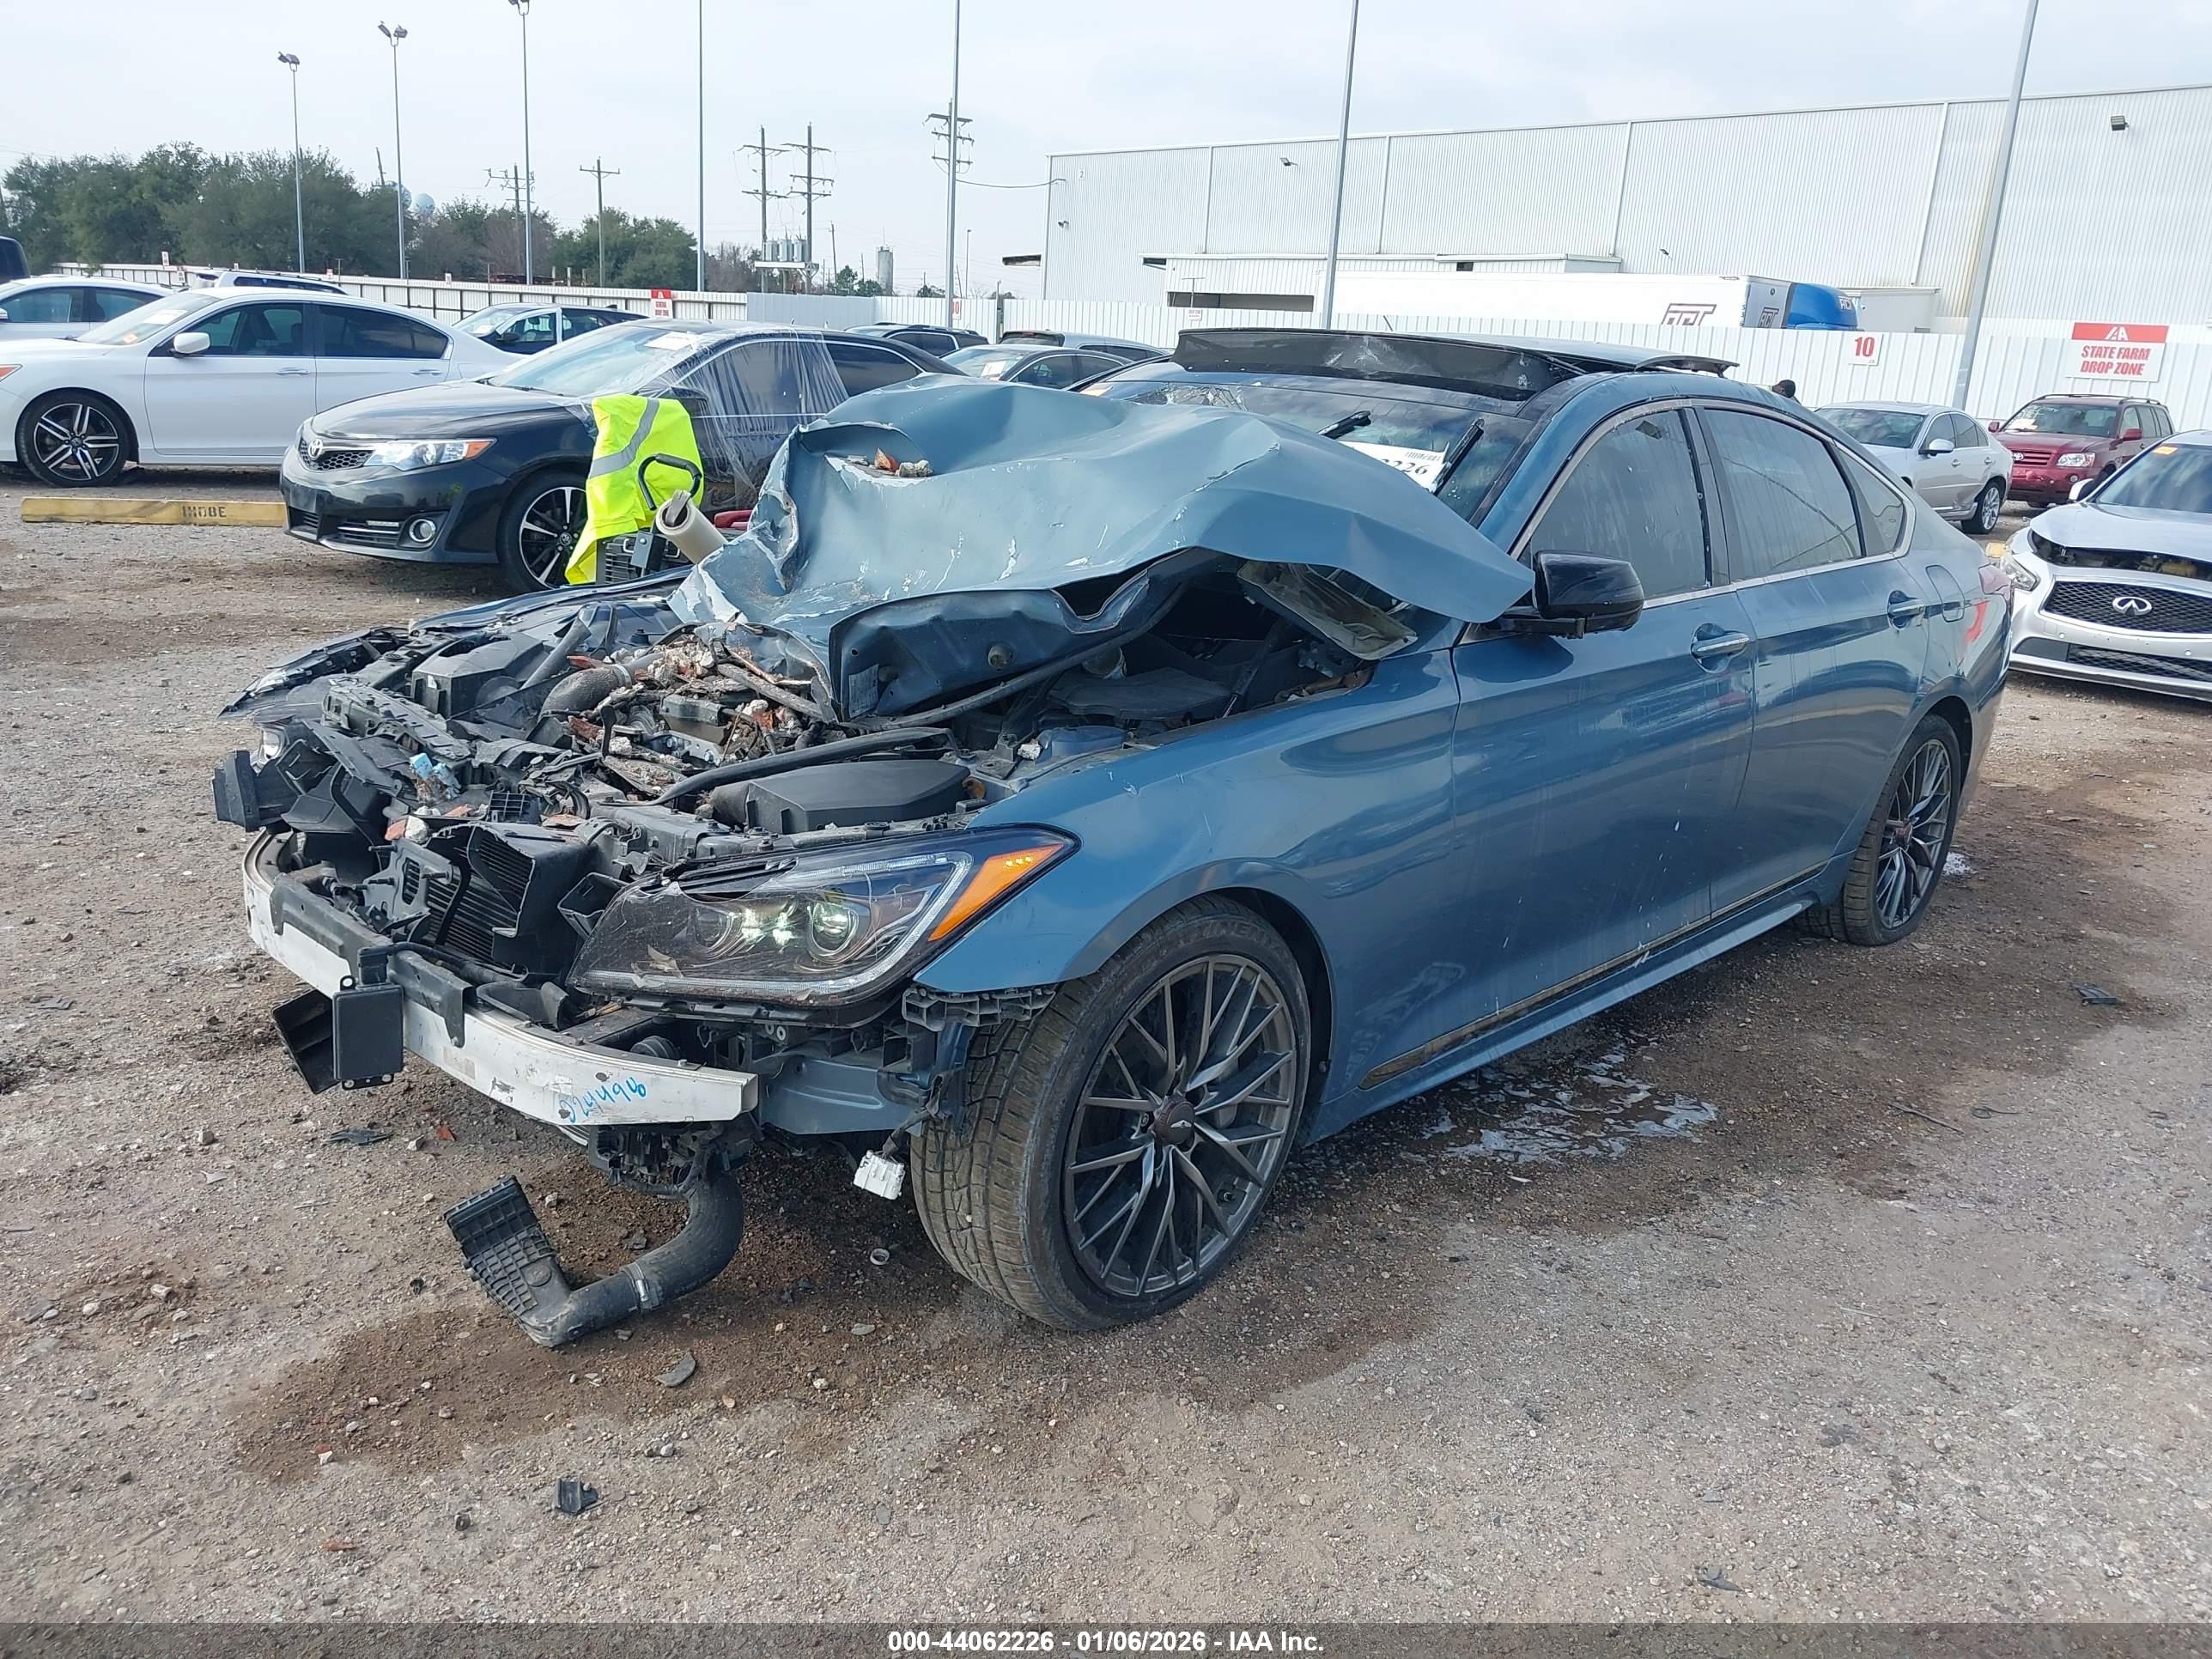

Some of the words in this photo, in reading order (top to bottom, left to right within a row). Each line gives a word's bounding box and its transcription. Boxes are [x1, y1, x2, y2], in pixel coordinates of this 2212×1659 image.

[1854, 337, 1875, 357] 10
[2081, 345, 2117, 360] STATE
[2116, 346, 2152, 361] FARM
[2080, 361, 2113, 374] DROP
[2113, 362, 2145, 375] ZONE
